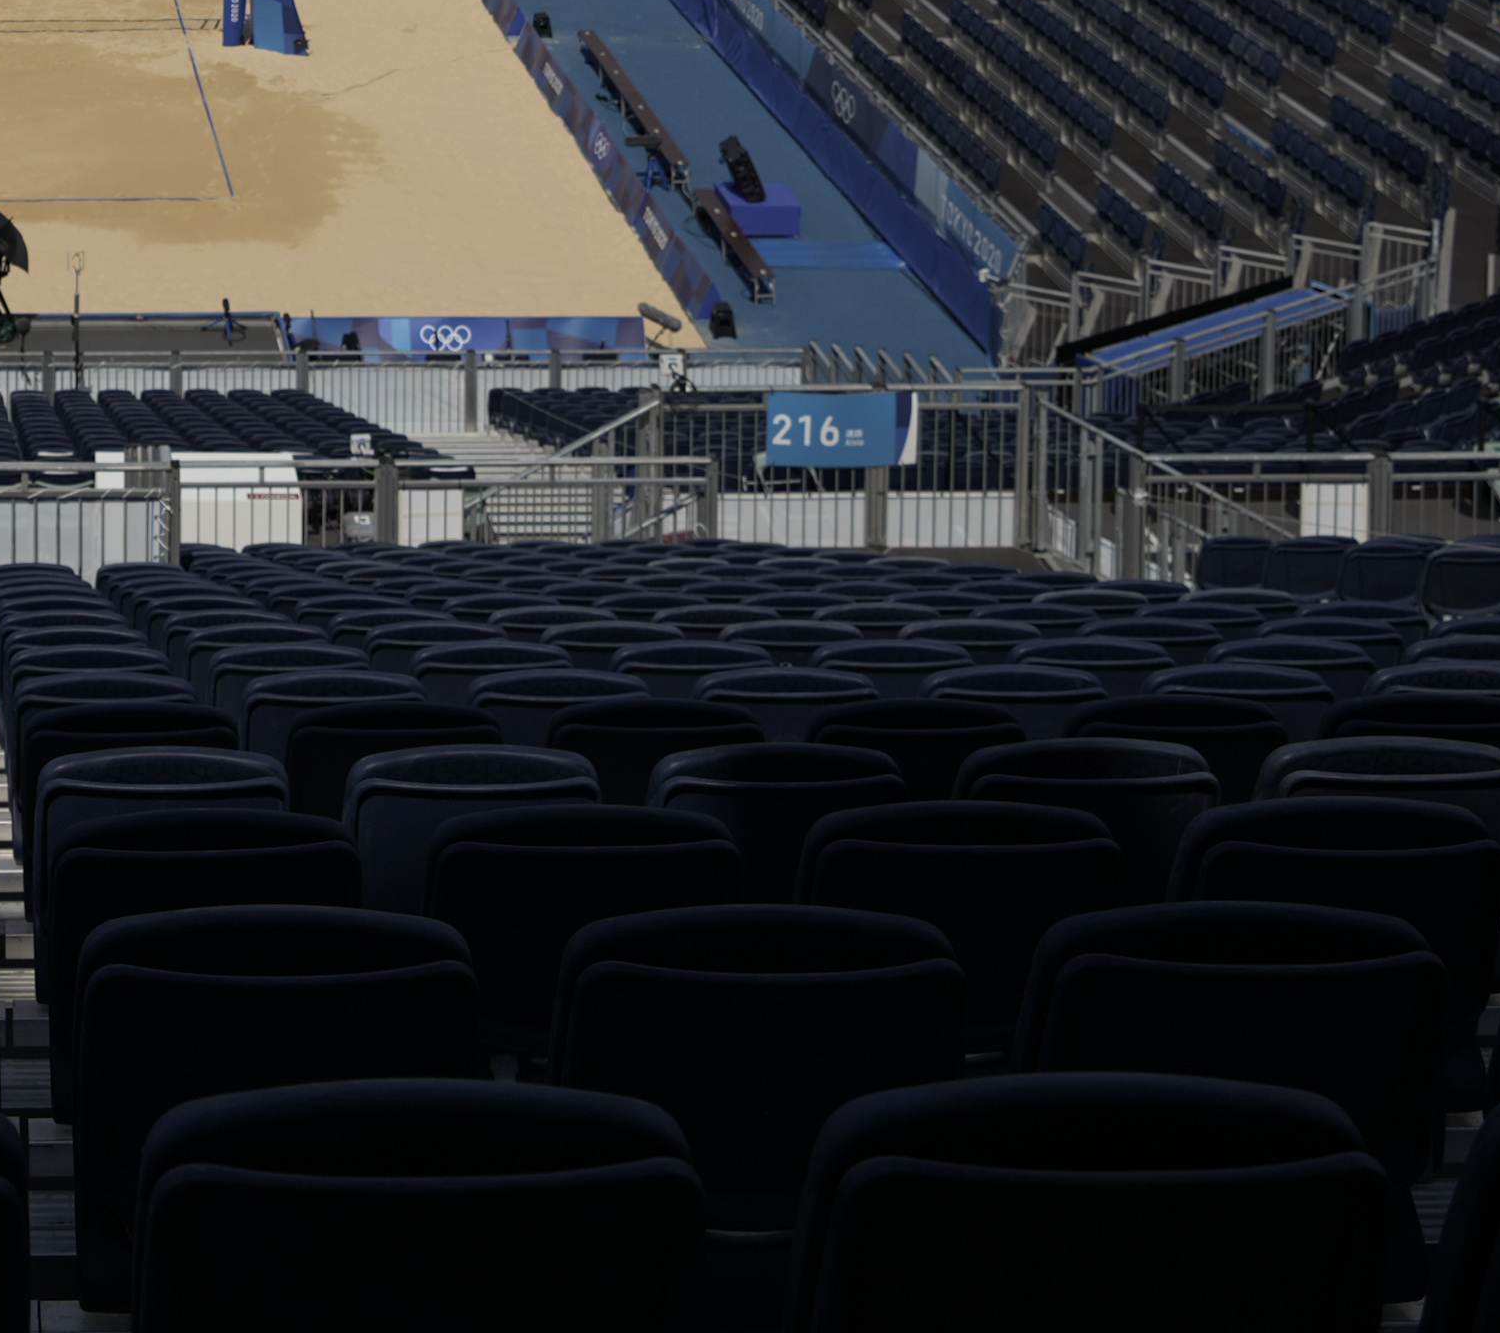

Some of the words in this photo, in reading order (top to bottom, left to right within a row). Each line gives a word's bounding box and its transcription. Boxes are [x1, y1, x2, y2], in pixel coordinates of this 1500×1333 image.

[230, 4, 240, 23] 2020
[940, 193, 974, 247] TOKYO
[973, 229, 1002, 276] 2020
[771, 414, 840, 447] 216
